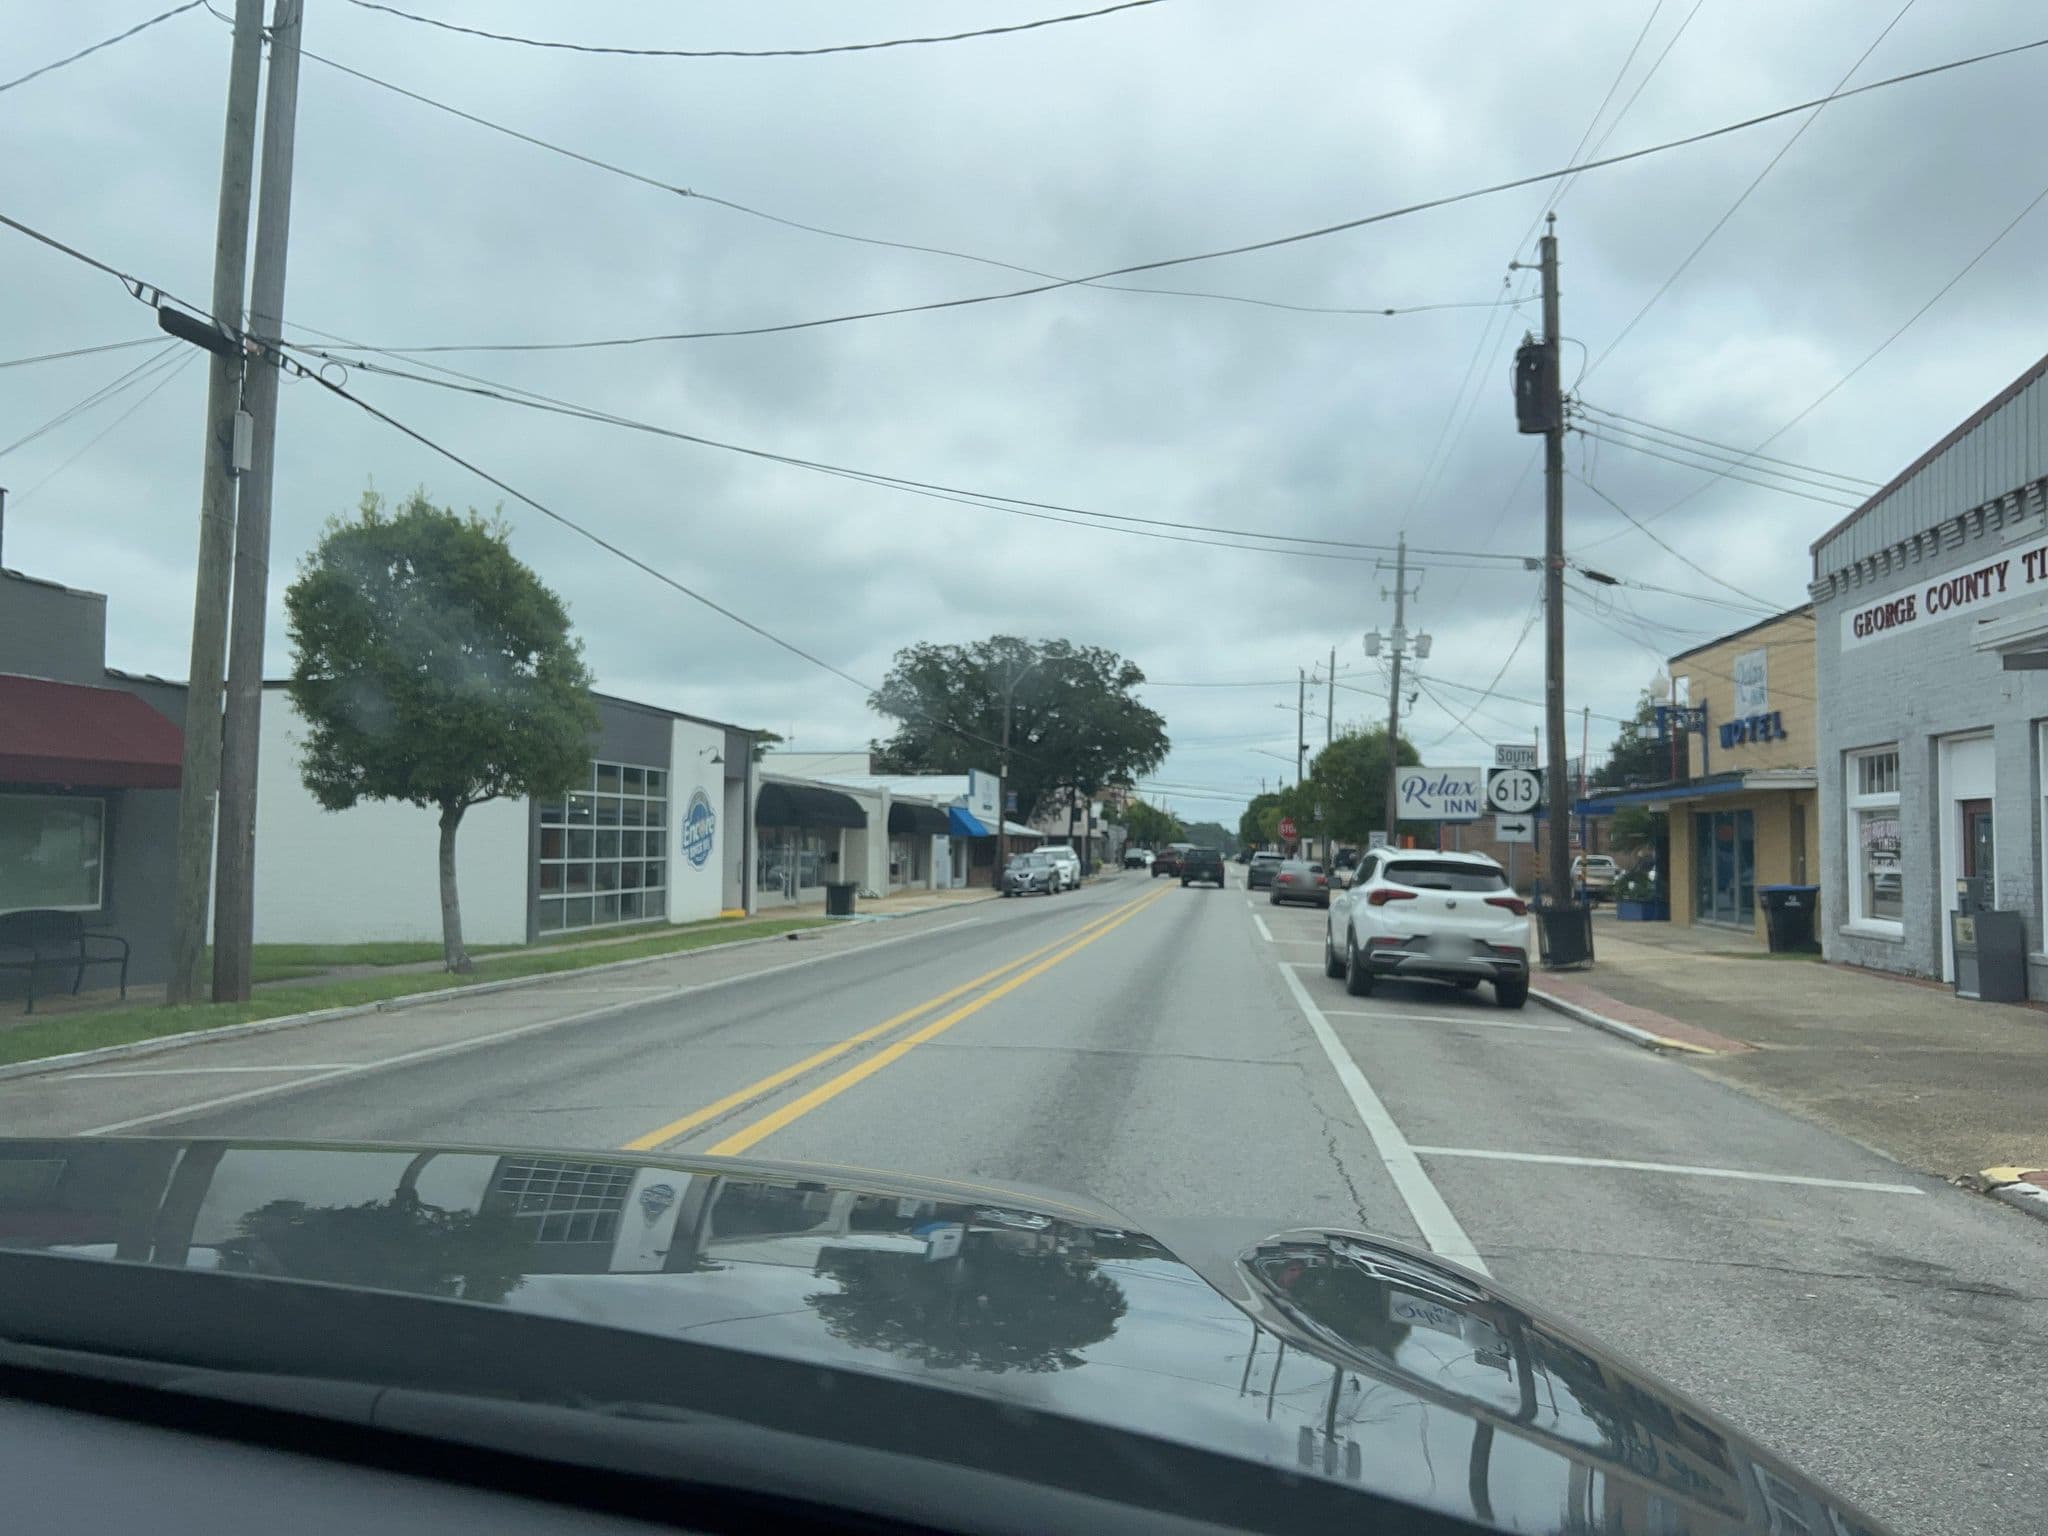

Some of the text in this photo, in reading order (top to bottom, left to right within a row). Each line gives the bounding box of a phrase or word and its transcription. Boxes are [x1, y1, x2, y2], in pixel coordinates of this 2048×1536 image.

[1853, 546, 2048, 638] GEORGE COUNTY TI
[1498, 748, 1534, 762] SOUTH
[1401, 773, 1478, 808] Relax
[1495, 777, 1533, 802] 613
[1444, 799, 1478, 814] INN
